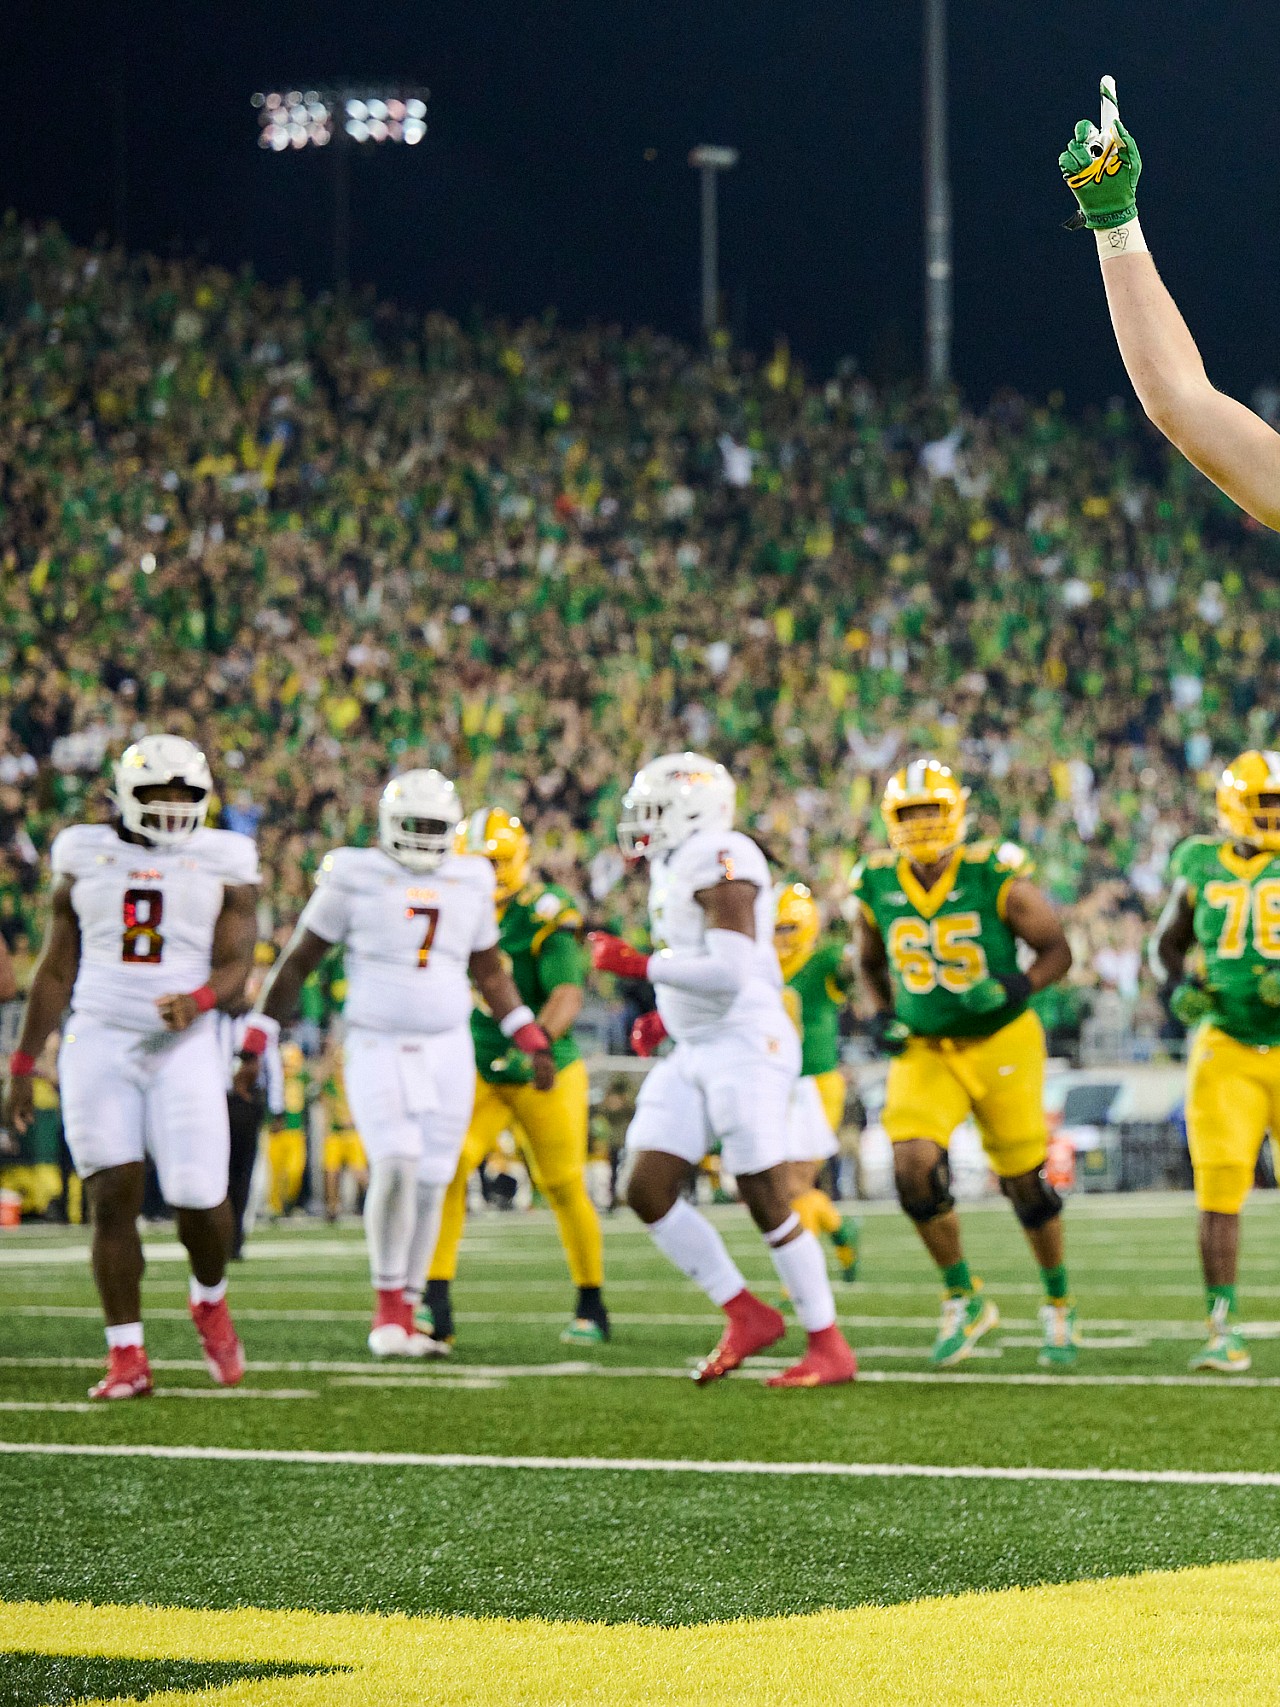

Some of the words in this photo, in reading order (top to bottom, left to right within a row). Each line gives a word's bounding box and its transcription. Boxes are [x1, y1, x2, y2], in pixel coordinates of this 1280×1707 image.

[122, 888, 164, 963] 8
[404, 907, 440, 969] 7
[887, 911, 989, 995] 65
